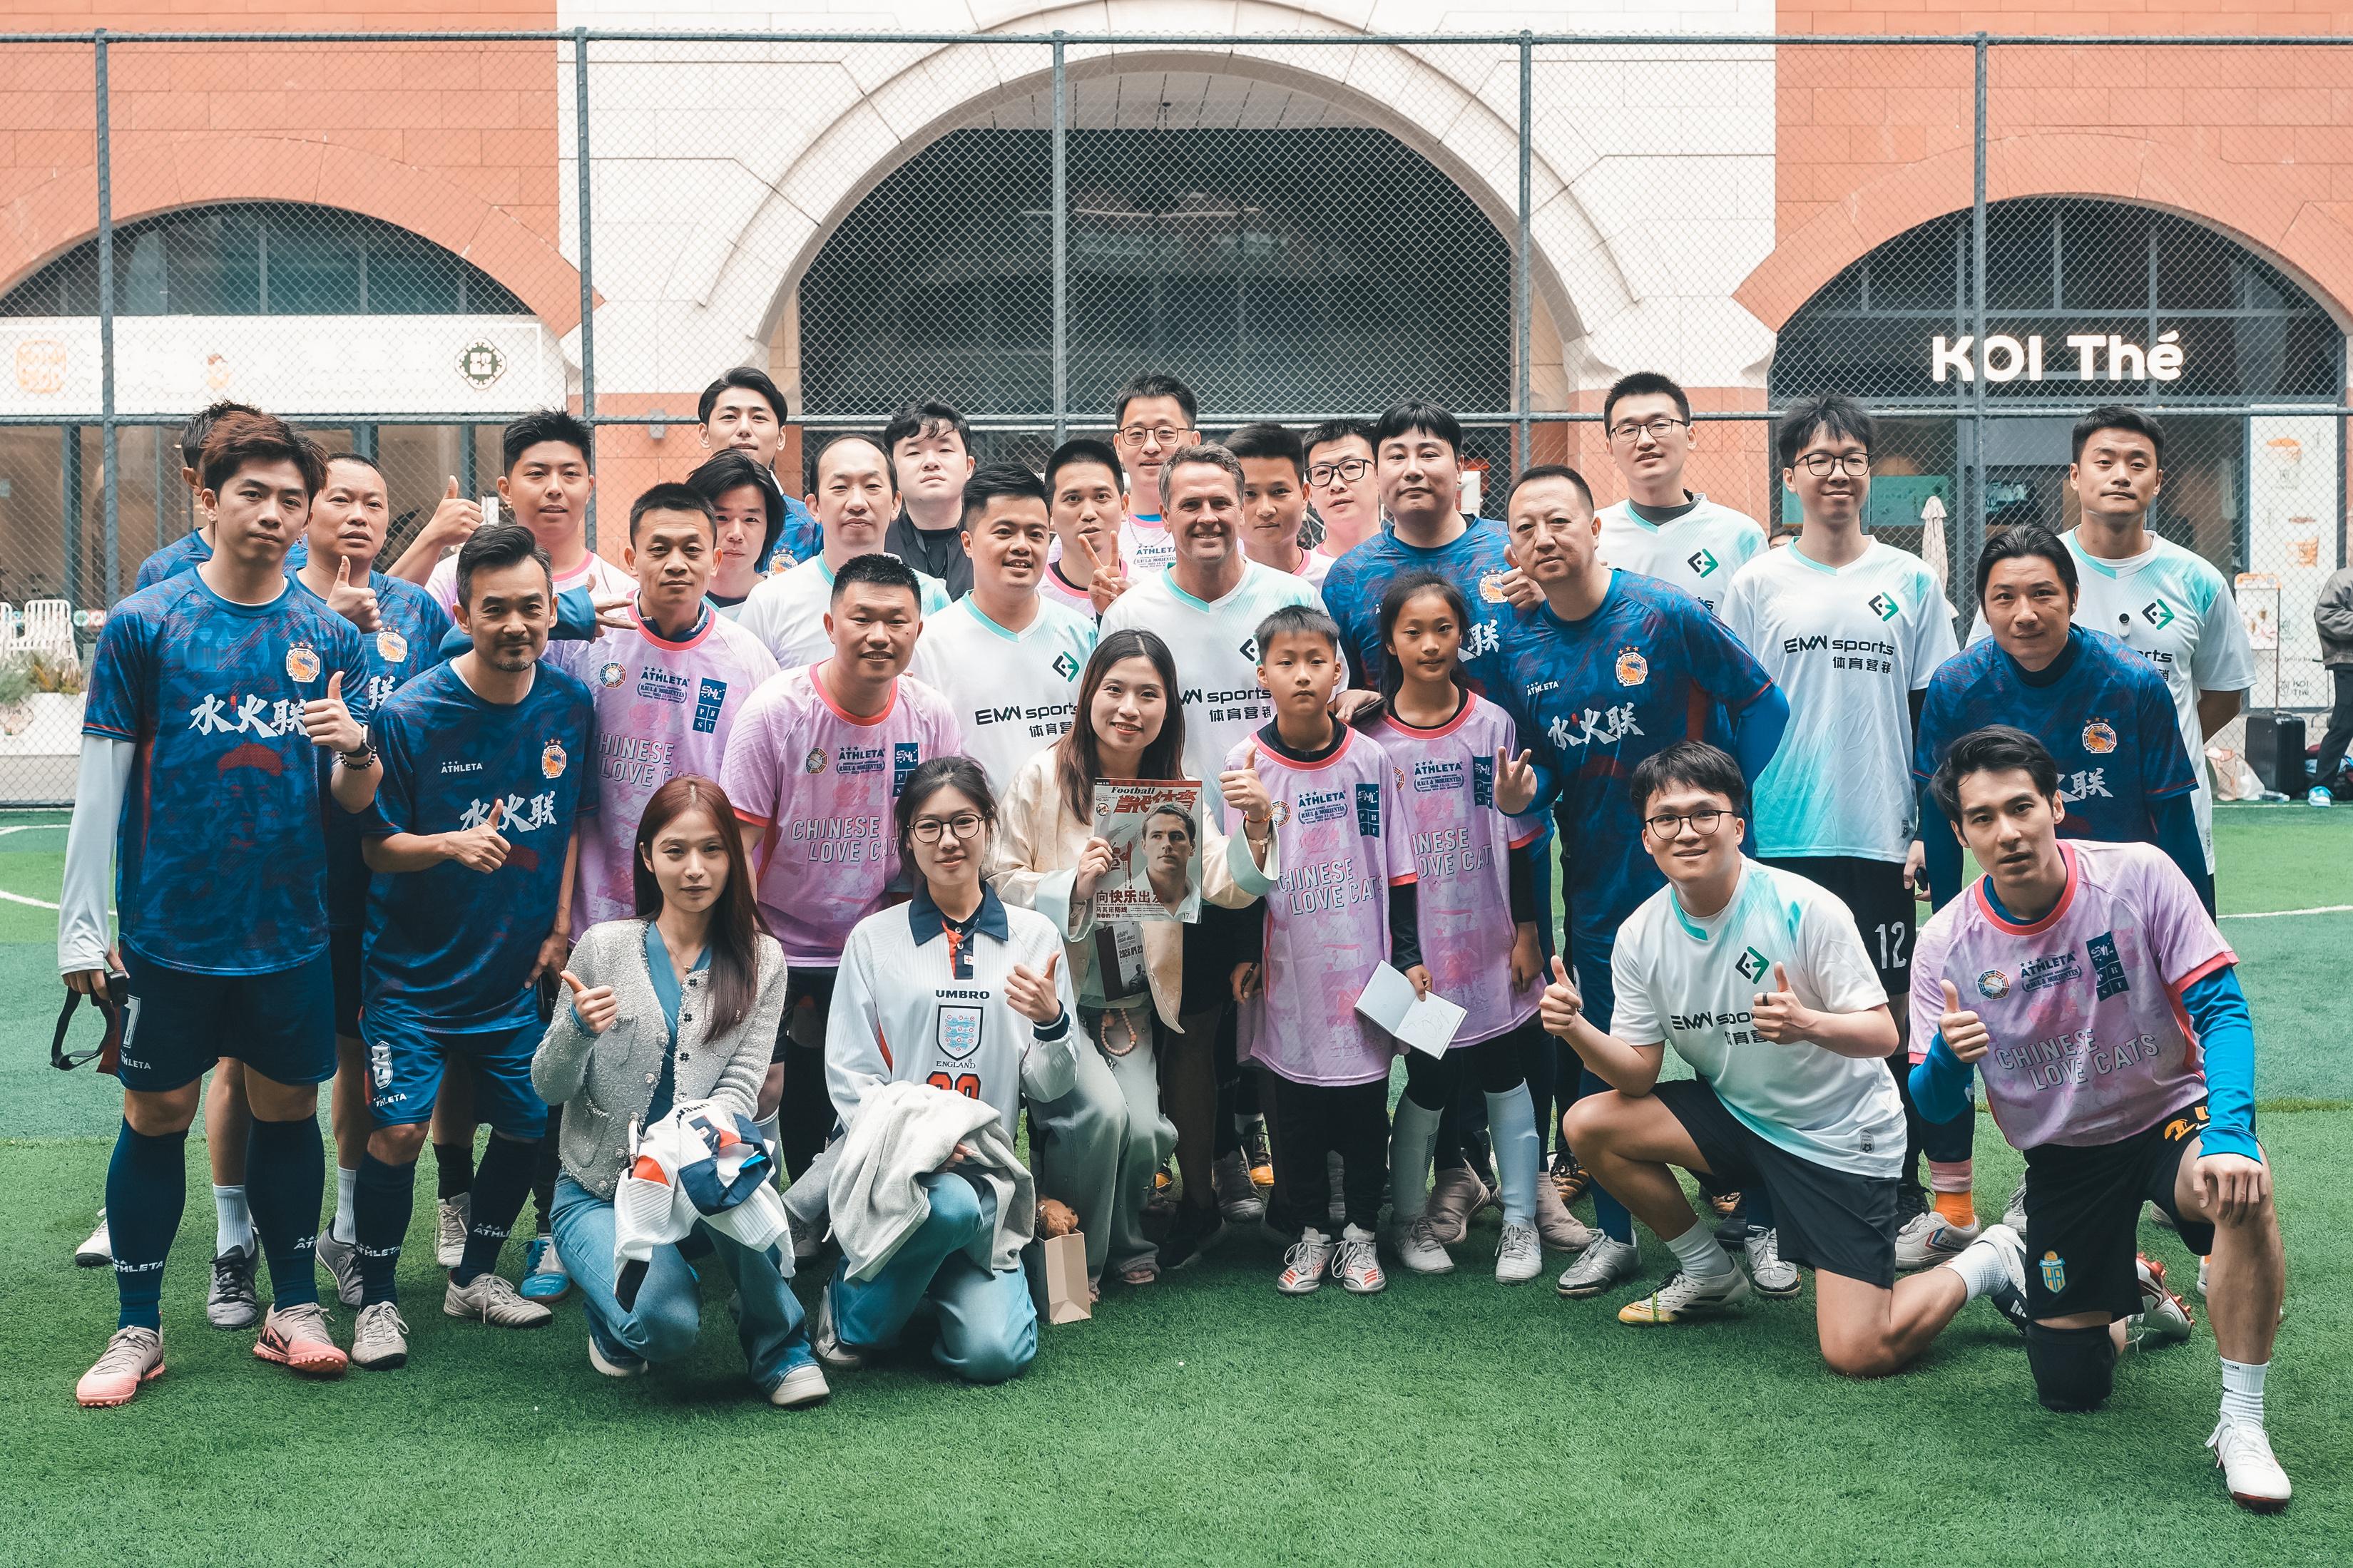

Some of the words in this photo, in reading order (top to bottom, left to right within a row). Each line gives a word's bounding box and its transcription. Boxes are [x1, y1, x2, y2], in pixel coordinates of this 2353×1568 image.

[1932, 334, 2042, 382] KOI
[2066, 329, 2184, 381] Thé
[1832, 640, 1895, 656] sports
[640, 671, 690, 687] ATHLETA
[1527, 680, 1559, 697] ATHLETA
[838, 748, 885, 761] ATHLETA
[441, 762, 483, 774] ATHLETA
[600, 757, 655, 788] LOVE
[1414, 762, 1463, 775] ATHLETA
[1298, 791, 1346, 808] ATHLETA
[791, 815, 881, 840] CHINESE
[807, 839, 862, 863] LOVE
[1415, 853, 1455, 879] OVE
[1289, 886, 1345, 916] LOVE
[1874, 921, 1907, 970] 12
[2021, 952, 2077, 978] ATHLETA
[936, 990, 990, 999] UMBRO
[1996, 1028, 2100, 1070] CHINESE
[936, 1060, 976, 1069] ENGLAND
[2028, 1058, 2088, 1091] LOVE
[2092, 1034, 2159, 1075] CATS
